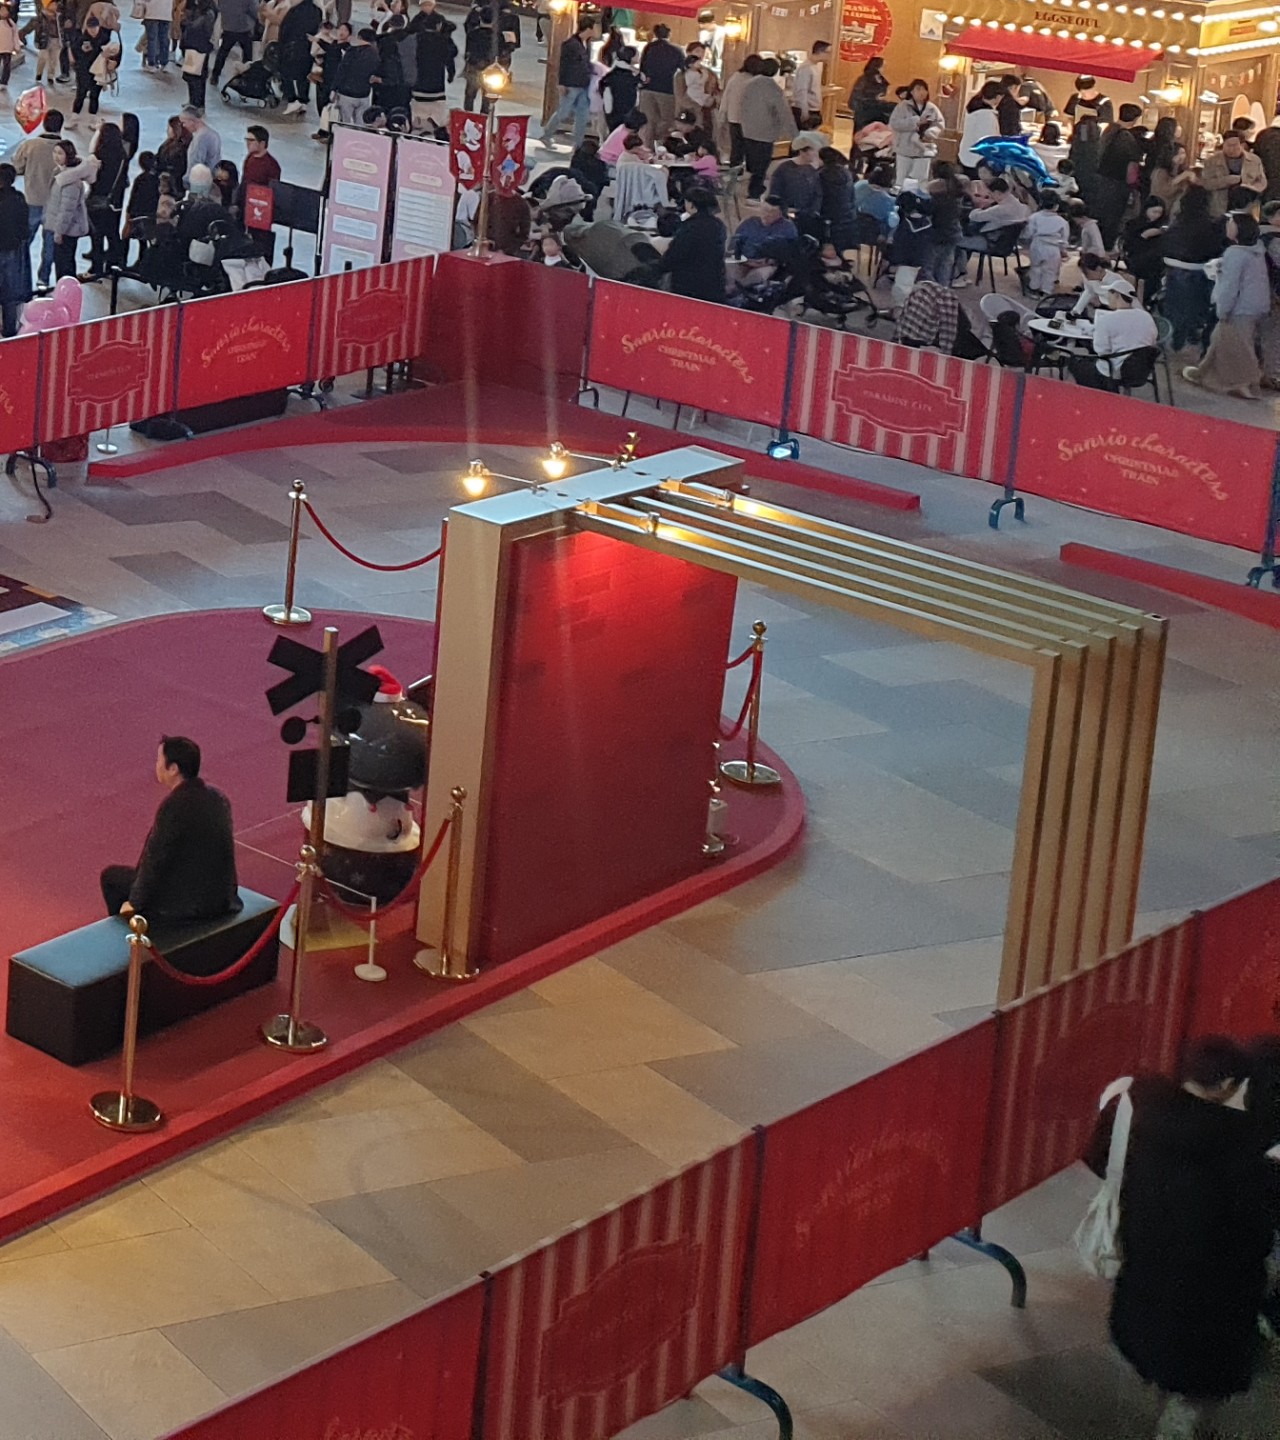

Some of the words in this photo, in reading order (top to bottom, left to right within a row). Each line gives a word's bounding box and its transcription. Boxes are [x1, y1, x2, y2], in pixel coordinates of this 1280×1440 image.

[621, 321, 677, 355] Sanrio
[676, 322, 755, 385] characters
[1057, 427, 1128, 462] Sanrio
[1131, 432, 1230, 501] characters
